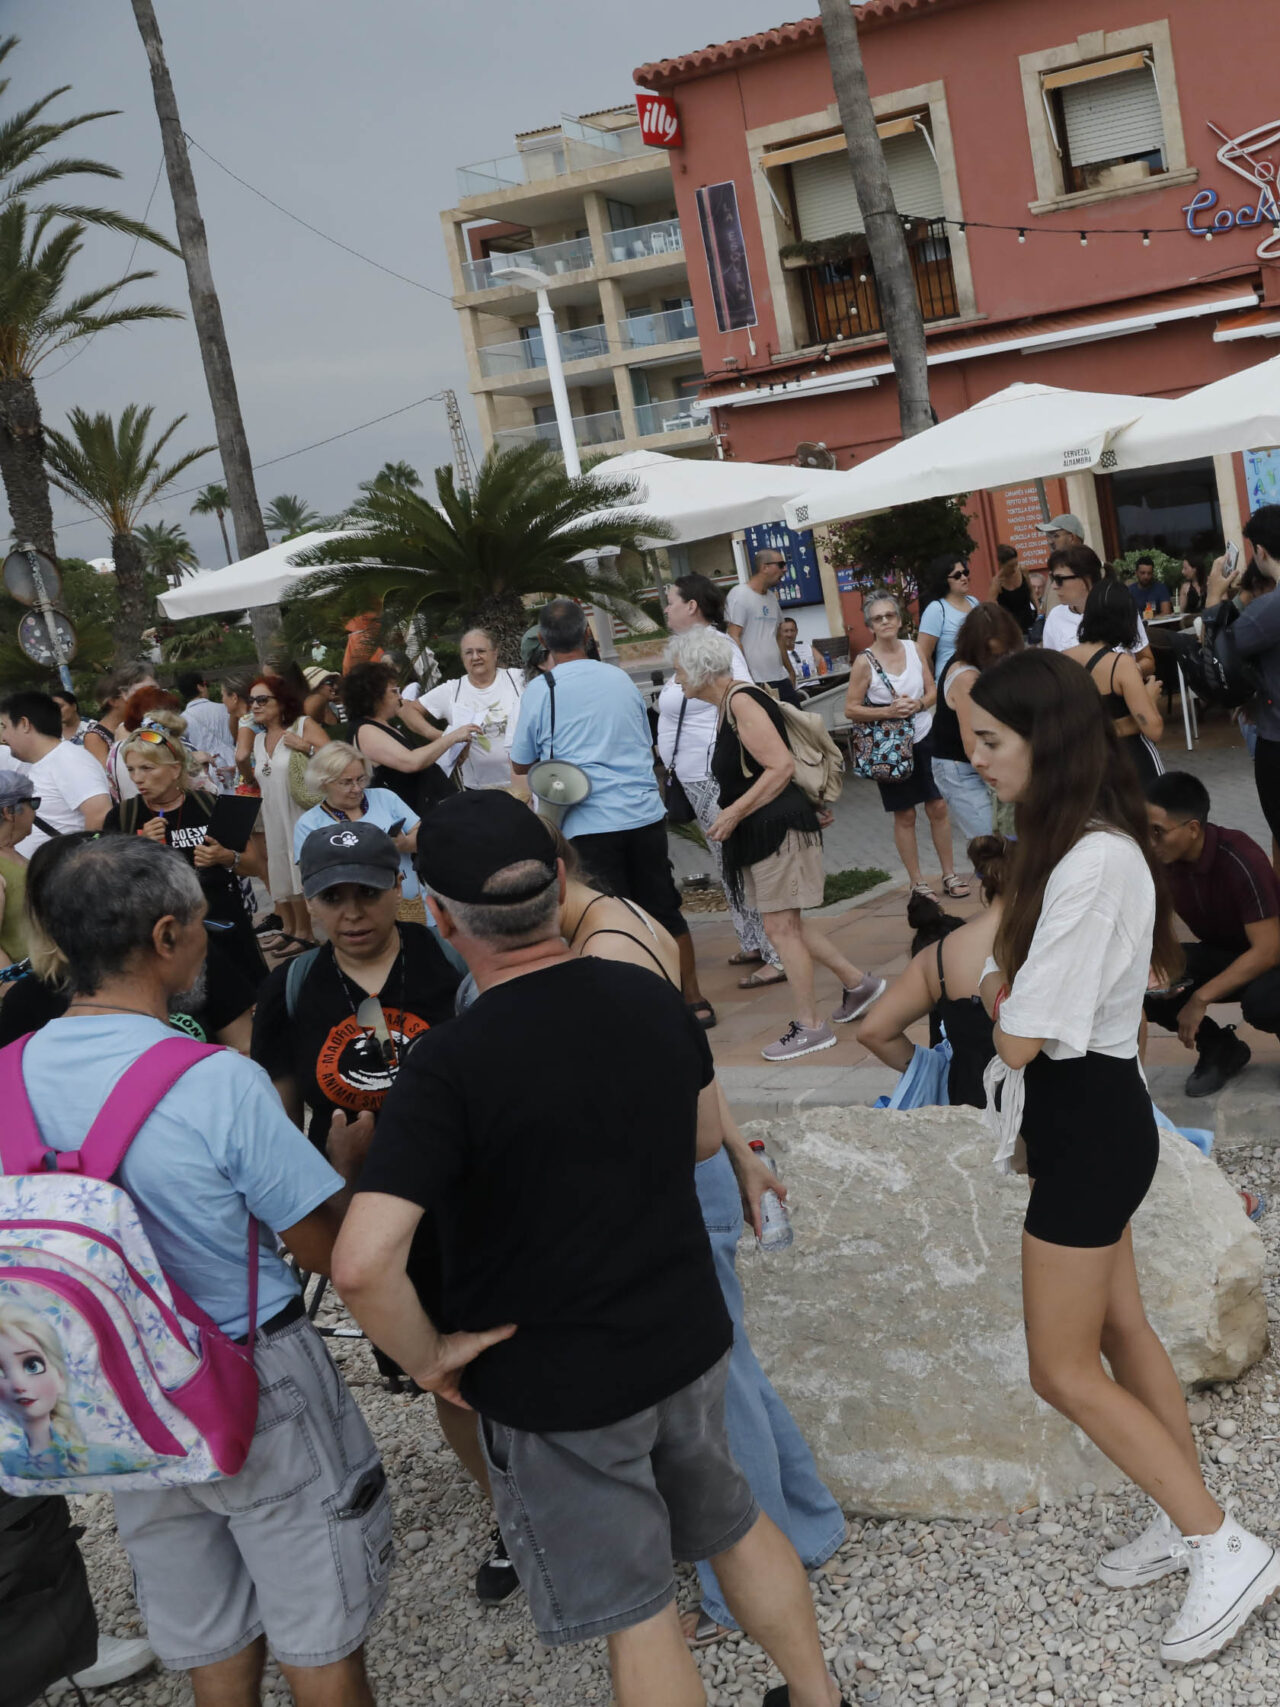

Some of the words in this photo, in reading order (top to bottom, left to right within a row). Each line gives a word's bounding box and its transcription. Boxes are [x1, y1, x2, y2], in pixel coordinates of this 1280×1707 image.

[643, 102, 677, 142] illy
[1063, 448, 1090, 459] CERVEZAS
[172, 836, 205, 848] CULTU
[322, 1072, 356, 1104] ANIMAL
[362, 1095, 385, 1108] SAV
